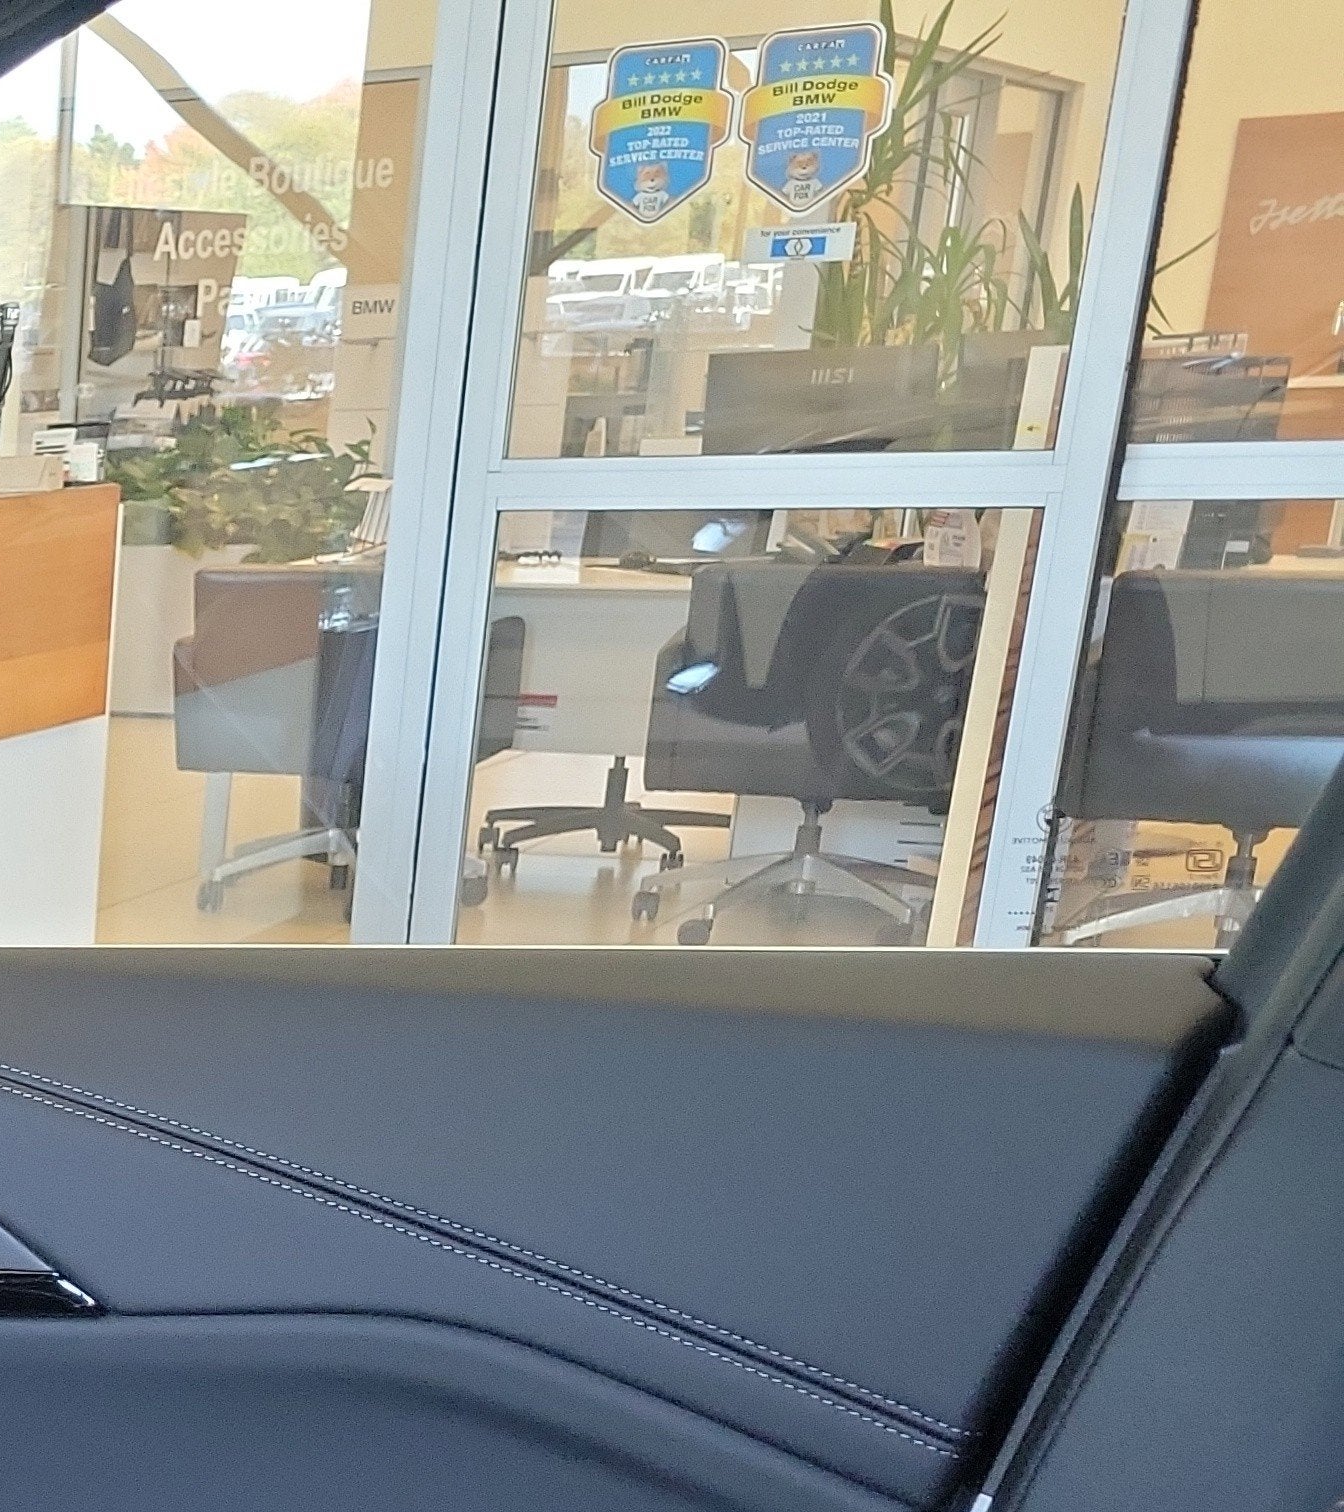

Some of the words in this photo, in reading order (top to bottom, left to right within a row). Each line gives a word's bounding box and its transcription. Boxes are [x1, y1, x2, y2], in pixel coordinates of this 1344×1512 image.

[772, 80, 799, 97] Bill
[802, 78, 859, 92] Dodge
[621, 94, 646, 110] Bill
[650, 92, 703, 106] Dodge
[792, 92, 836, 107] BMW
[640, 106, 682, 119] BMW
[795, 112, 827, 124] 2021
[646, 126, 672, 136] 2022
[776, 124, 845, 139] TOP-RATED
[627, 138, 689, 152] TOP-RATED
[758, 138, 809, 155] SERVICE
[812, 136, 860, 149] CENTER
[609, 150, 657, 167] SERVICE
[659, 149, 705, 162] CENTER
[153, 211, 349, 262] Accessories
[773, 228, 790, 238] your
[792, 226, 842, 237] convenience
[352, 299, 396, 316] BMW
